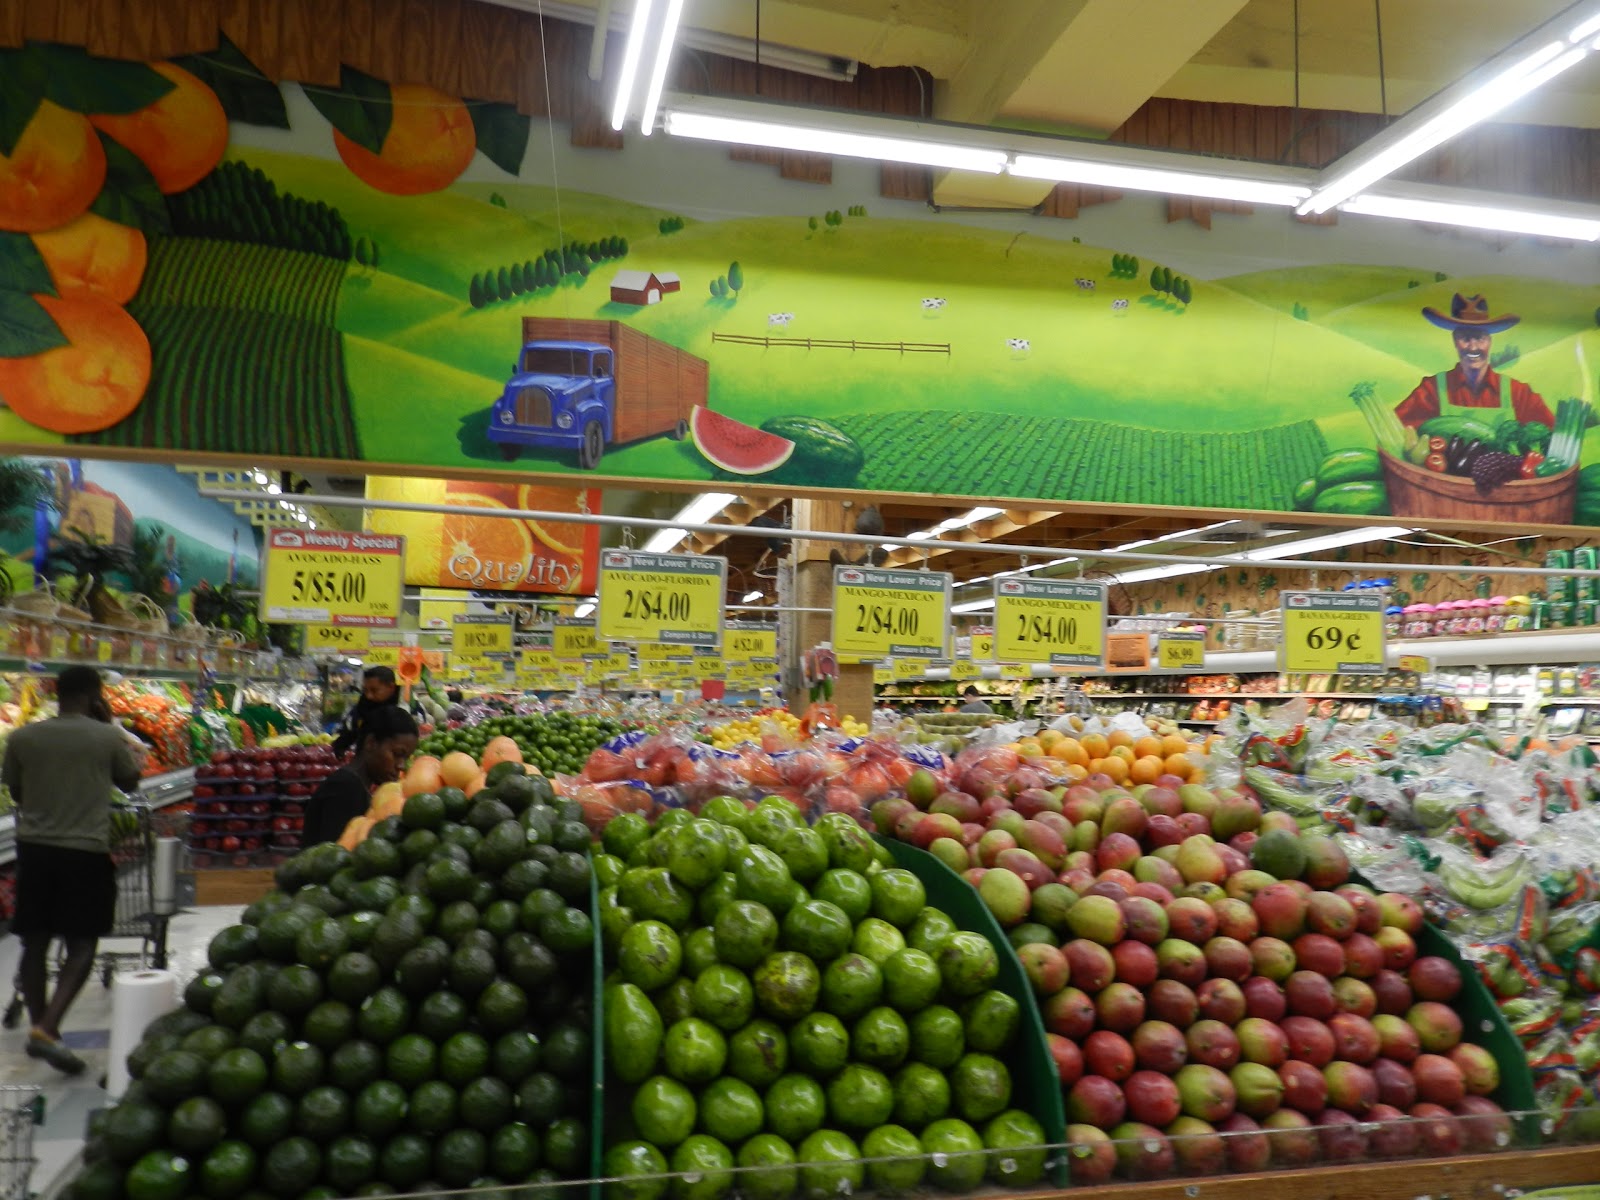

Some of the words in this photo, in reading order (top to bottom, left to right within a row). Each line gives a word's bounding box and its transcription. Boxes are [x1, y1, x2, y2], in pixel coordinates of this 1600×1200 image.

[305, 532, 349, 549] Weekly
[352, 536, 398, 550] Special
[634, 557, 656, 567] New
[658, 559, 688, 569] Lower
[691, 560, 716, 570] Price
[448, 553, 583, 593] Quality
[609, 572, 711, 586] AVOCADO-FLORIDA
[865, 573, 886, 583] New
[889, 574, 917, 585] Lower
[919, 576, 943, 587] Price
[292, 571, 366, 603] 5/$5.00
[1025, 584, 1046, 594] New
[1047, 585, 1074, 595] Lower
[1076, 587, 1099, 597] Price
[844, 587, 936, 602] MANGO-MEXICAN
[623, 589, 691, 621] 2/$4.00
[1006, 597, 1093, 611] MANGO-MEXICAN
[1311, 597, 1331, 606] New
[1332, 598, 1357, 606] Lower
[1358, 598, 1380, 607] Price
[856, 604, 919, 636] 2/$4.00
[1298, 611, 1370, 621] BANANA-GREEN
[663, 631, 691, 639] Compare
[1018, 614, 1077, 645] 2/$4.00
[1306, 626, 1362, 656] 69¢
